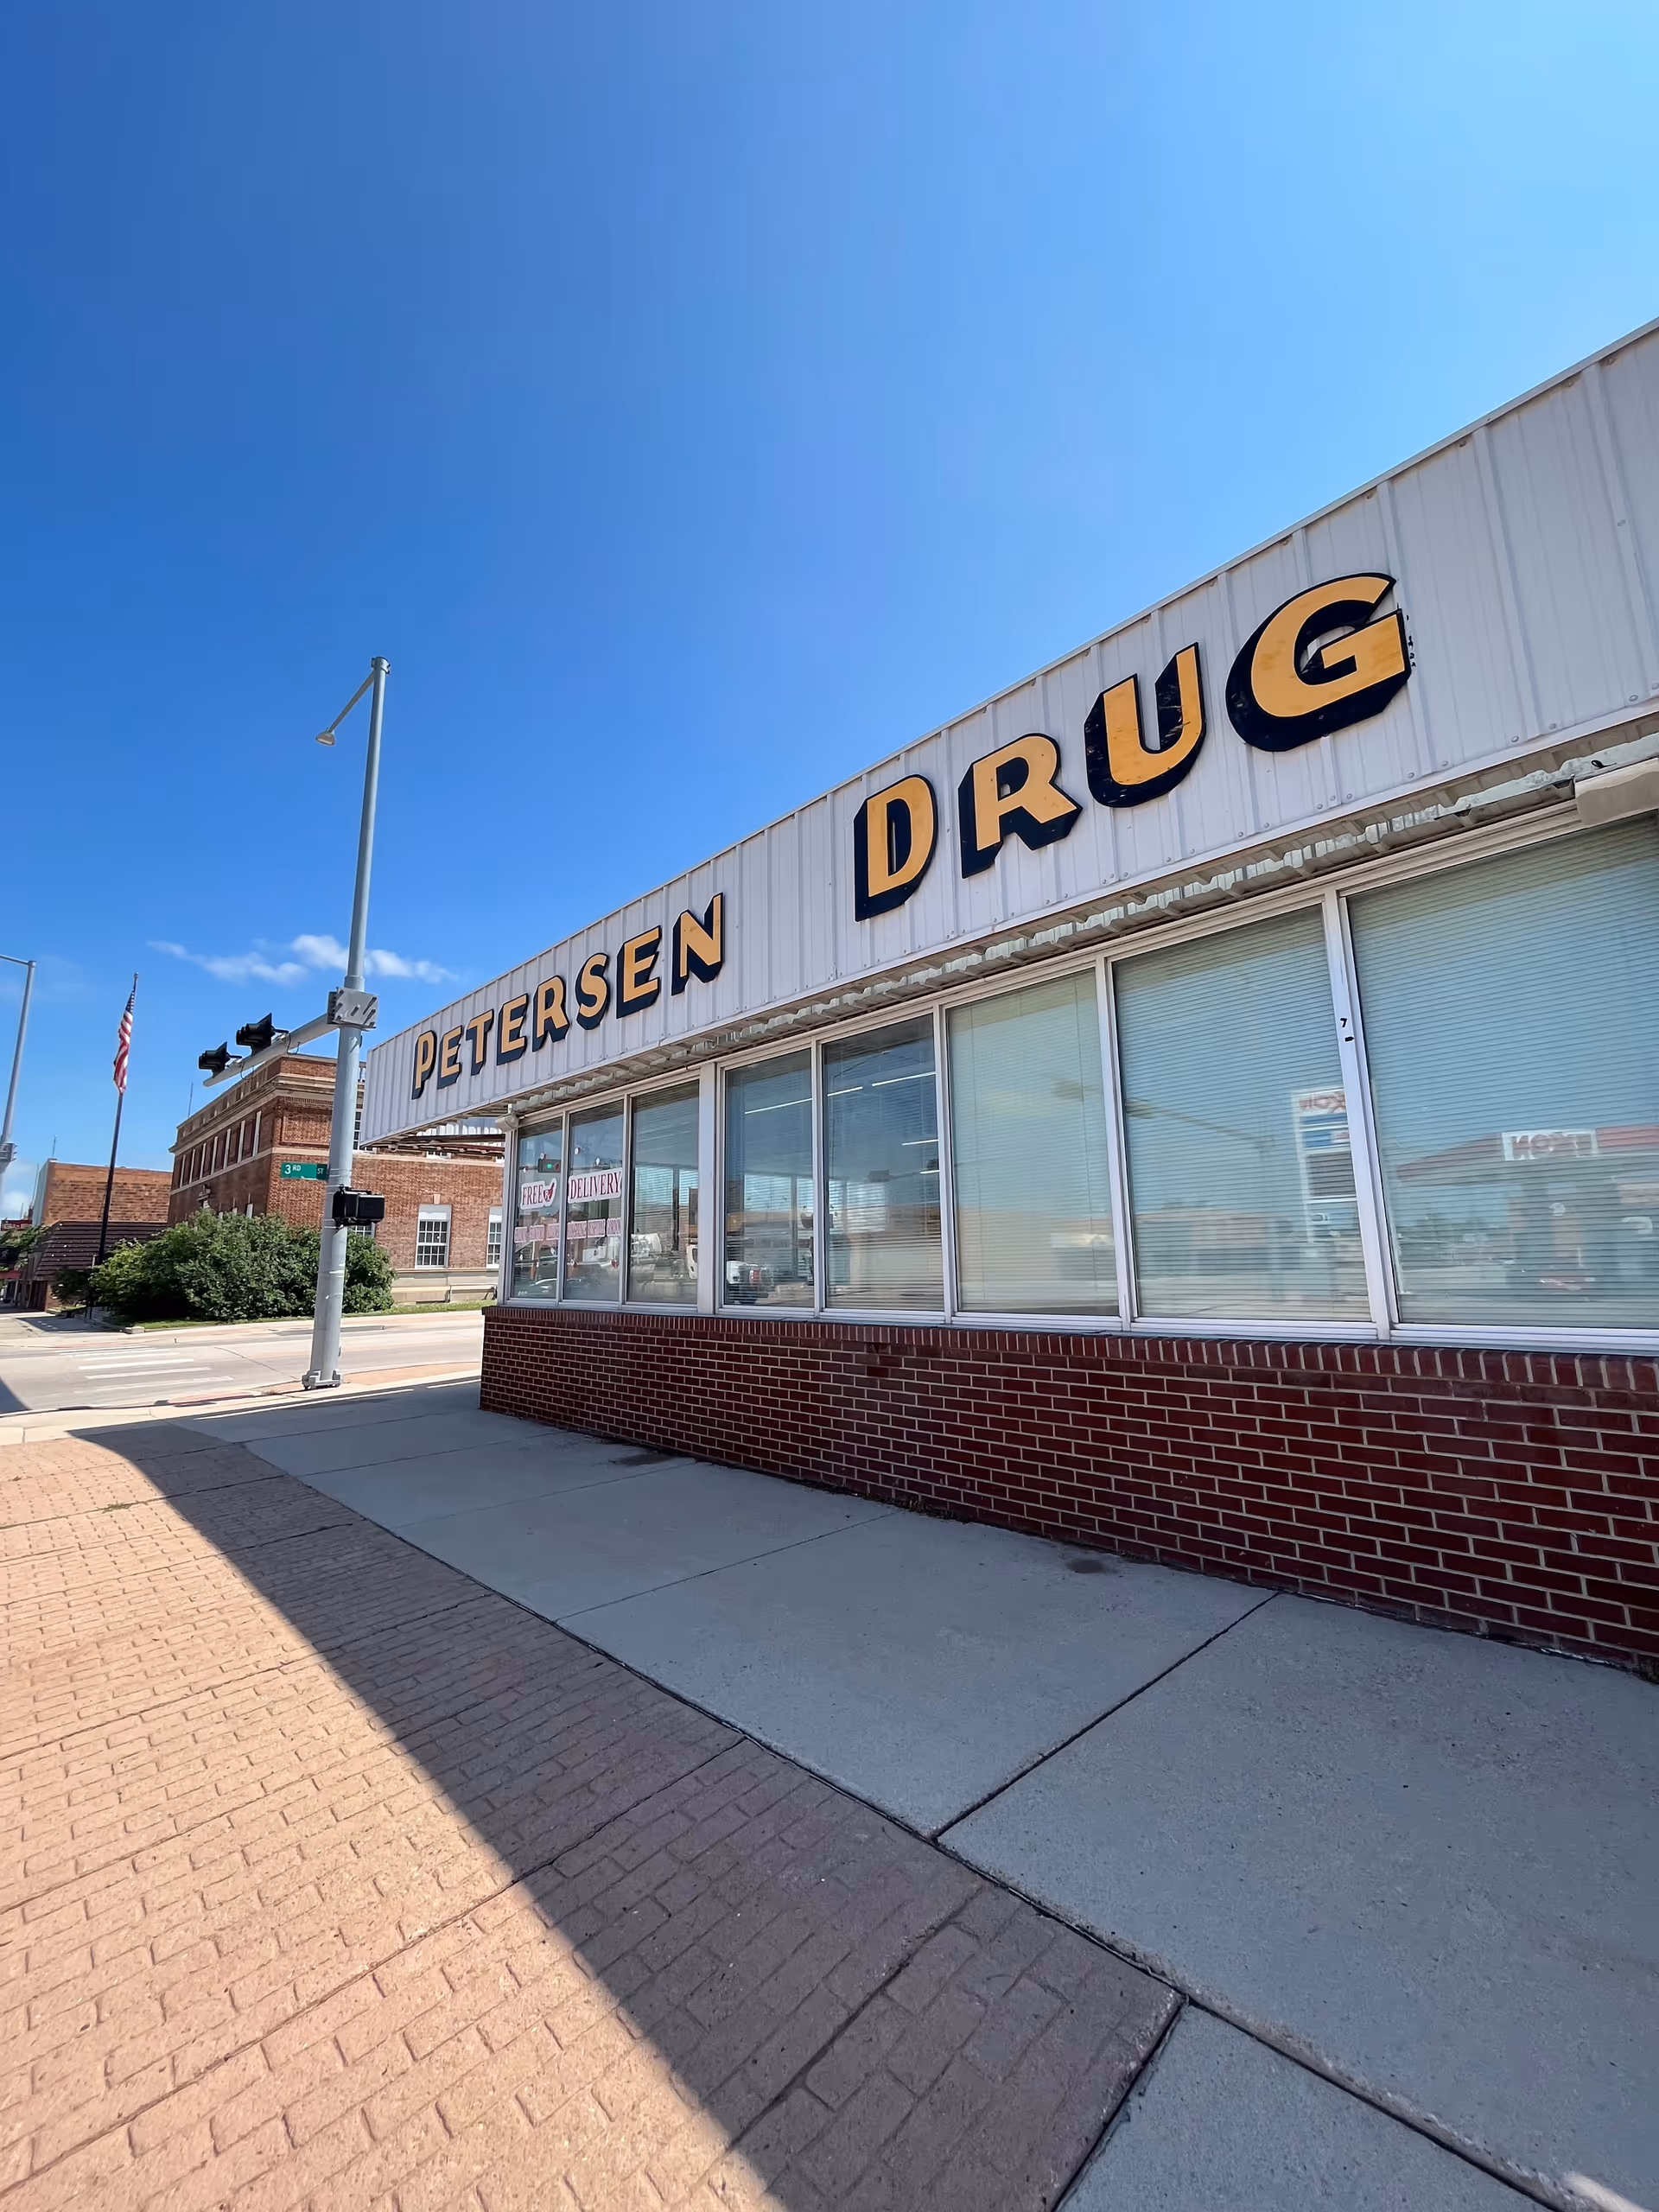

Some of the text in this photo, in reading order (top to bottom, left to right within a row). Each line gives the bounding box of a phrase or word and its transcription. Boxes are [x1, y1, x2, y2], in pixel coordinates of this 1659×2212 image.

[410, 572, 1412, 1100] PETERSEN DRUG
[522, 1184, 543, 1205] FREE
[569, 1172, 620, 1199] DELIVERY
